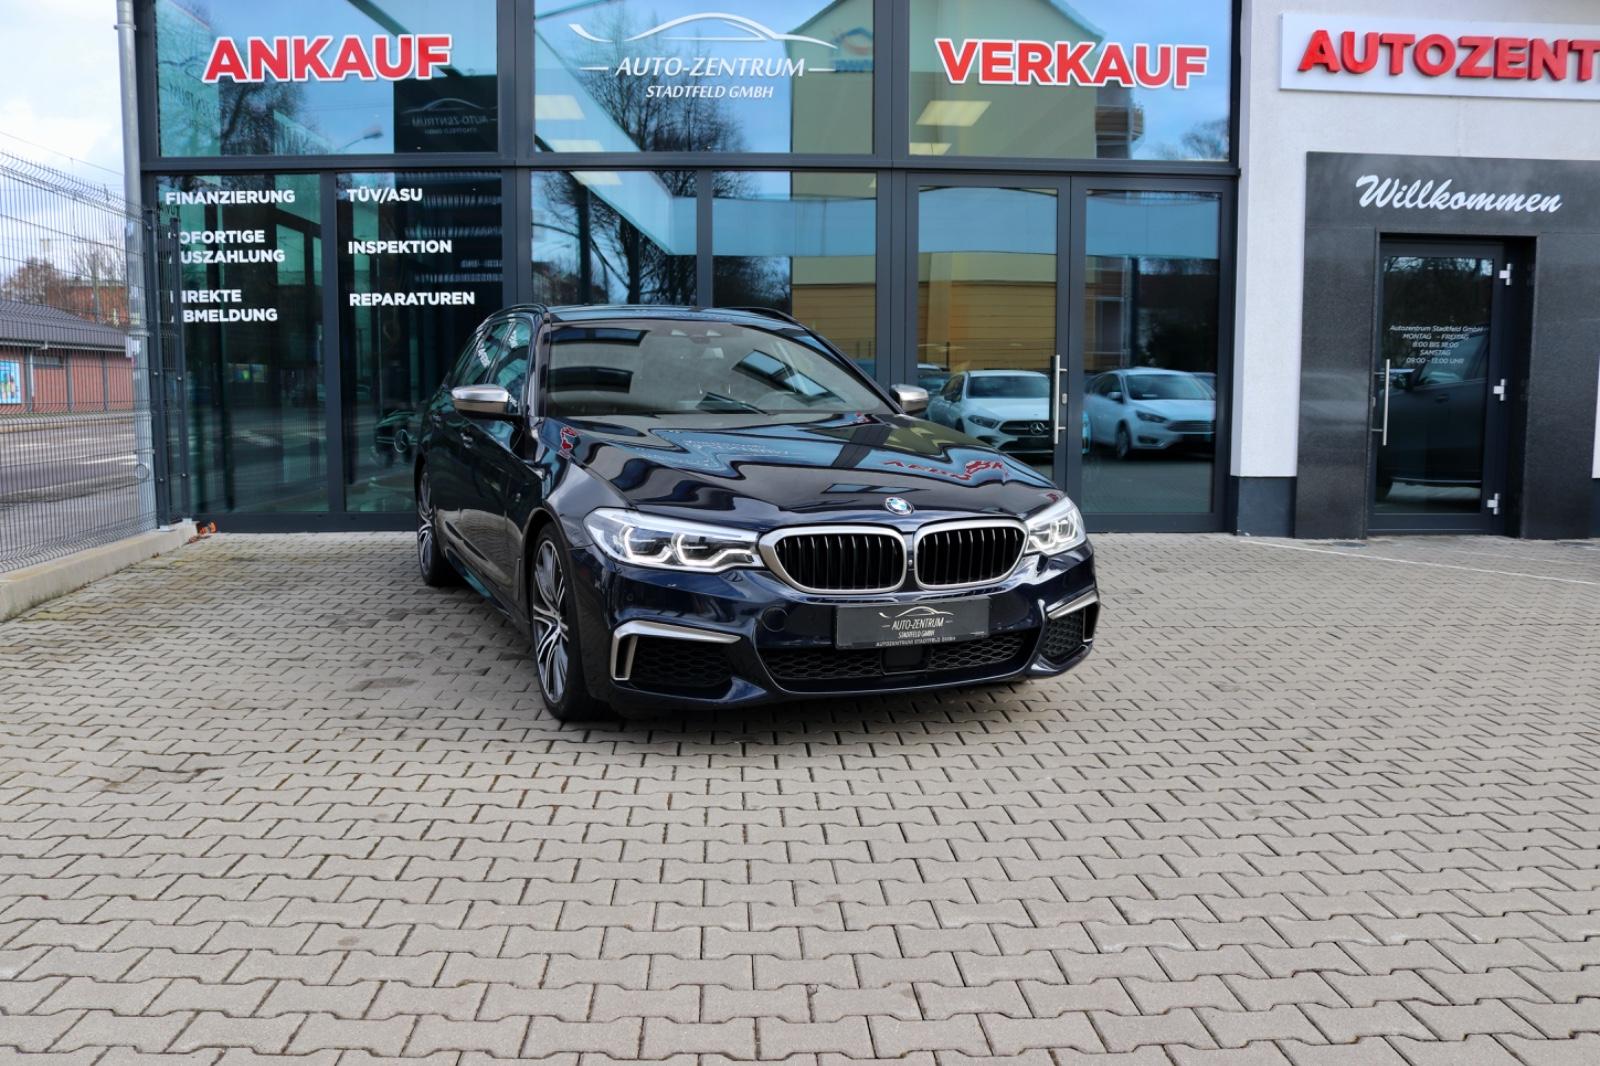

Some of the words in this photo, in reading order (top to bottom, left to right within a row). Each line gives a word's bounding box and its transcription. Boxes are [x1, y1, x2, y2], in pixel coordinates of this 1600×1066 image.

[202, 34, 452, 83] ANKAUF
[1298, 29, 1600, 82] AUTOZENT
[615, 56, 805, 79] AUTO-ZENTRUM
[935, 38, 1209, 89] VERKAUF
[646, 85, 726, 99] STADTFELD
[729, 86, 774, 99] GMBH
[165, 189, 295, 205] FINANZIERUNG
[346, 186, 423, 204] TÜV/ASU
[1356, 174, 1562, 213] Willkommen
[168, 230, 266, 245] OFORTIGE
[348, 240, 453, 255] INSPEKTION
[169, 249, 286, 264] USZAHLUNG
[170, 289, 242, 303] IREKTE
[349, 291, 476, 306] REPARATUREN
[171, 308, 278, 323] BMELDUNG
[892, 617, 944, 630] AUTO-ZENTRUM
